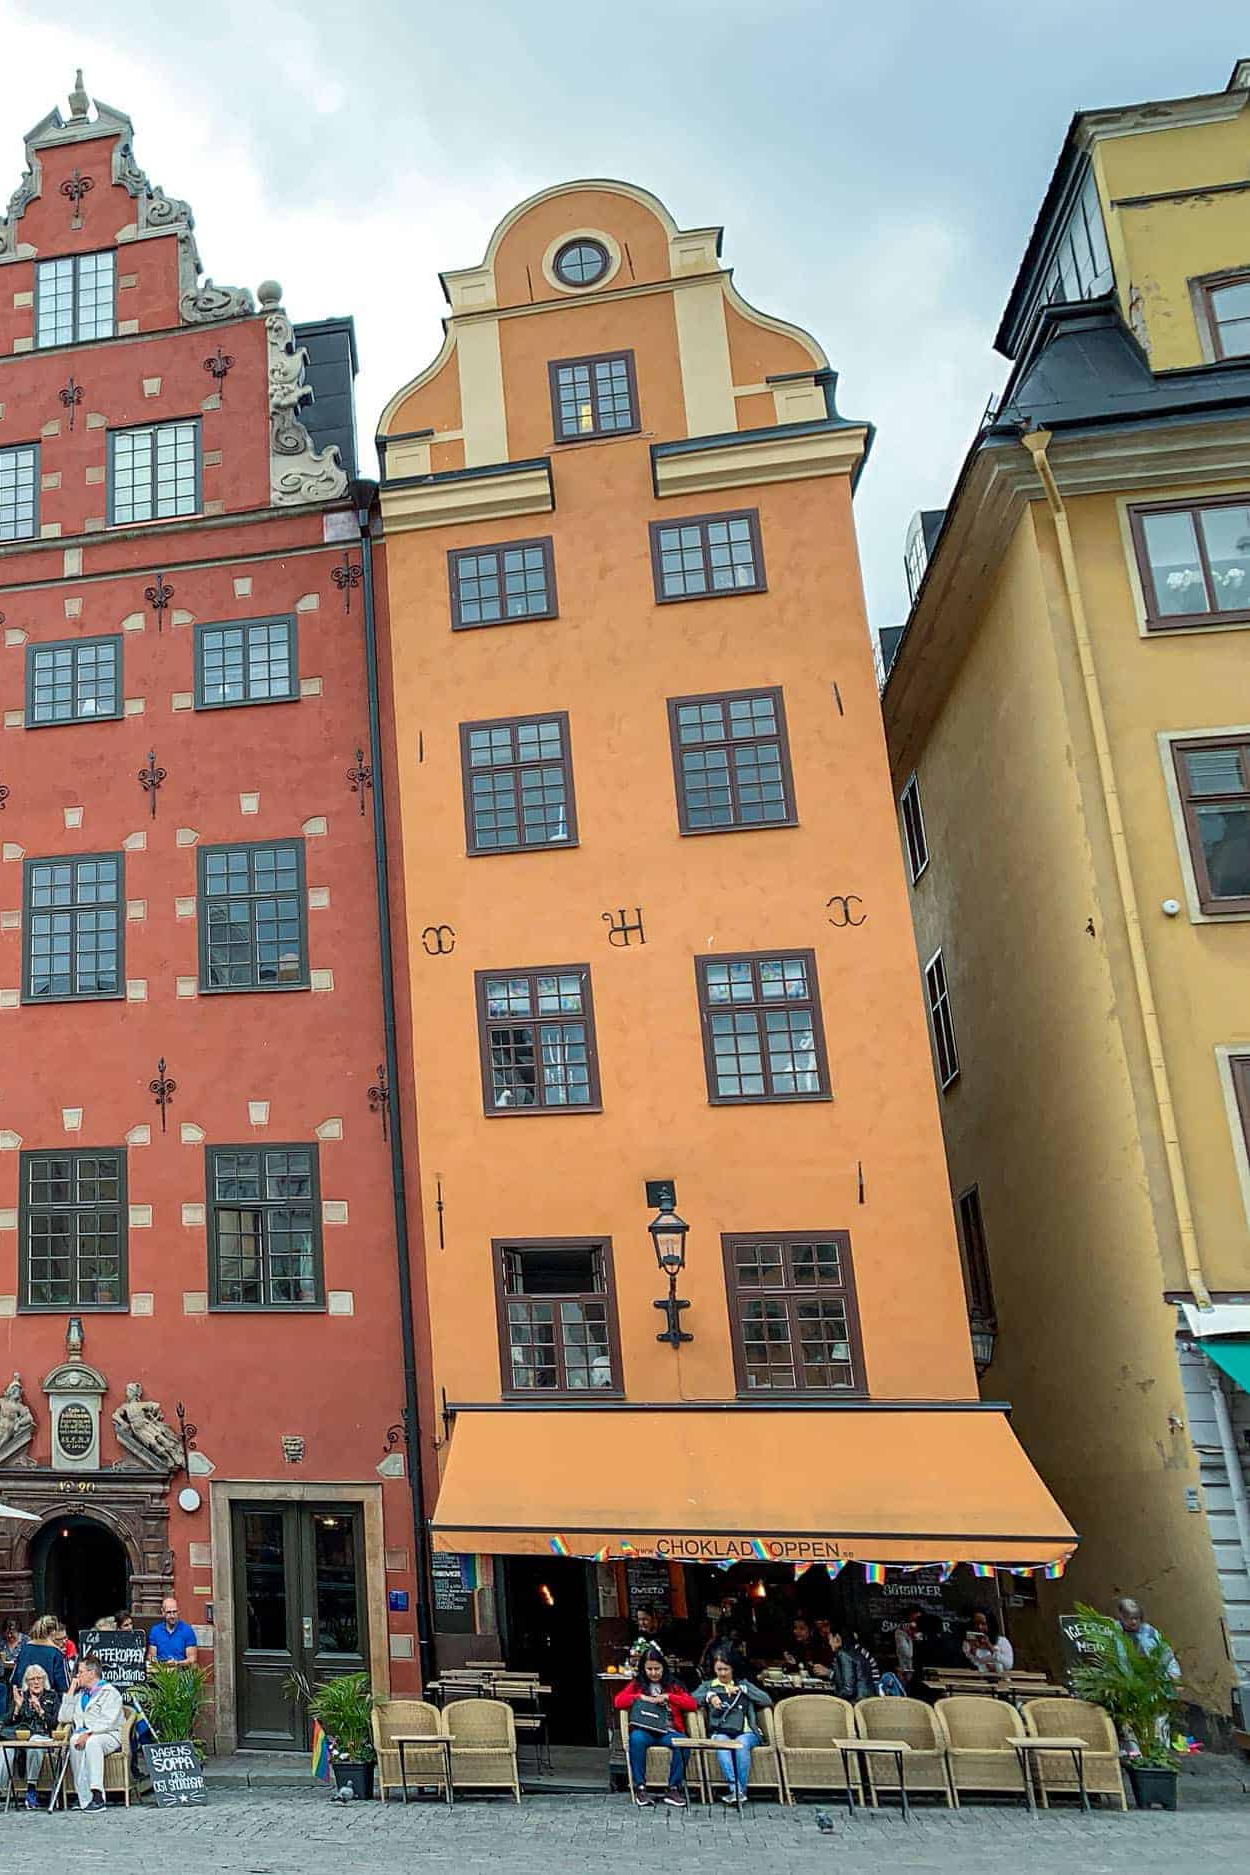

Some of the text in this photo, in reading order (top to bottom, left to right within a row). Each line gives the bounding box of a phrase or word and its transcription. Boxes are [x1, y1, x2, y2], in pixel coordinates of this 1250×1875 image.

[656, 1538, 840, 1558] CHOKLADOPPEN
[150, 1745, 192, 1760] DAGENS
[152, 1756, 195, 1772] SOPPA
